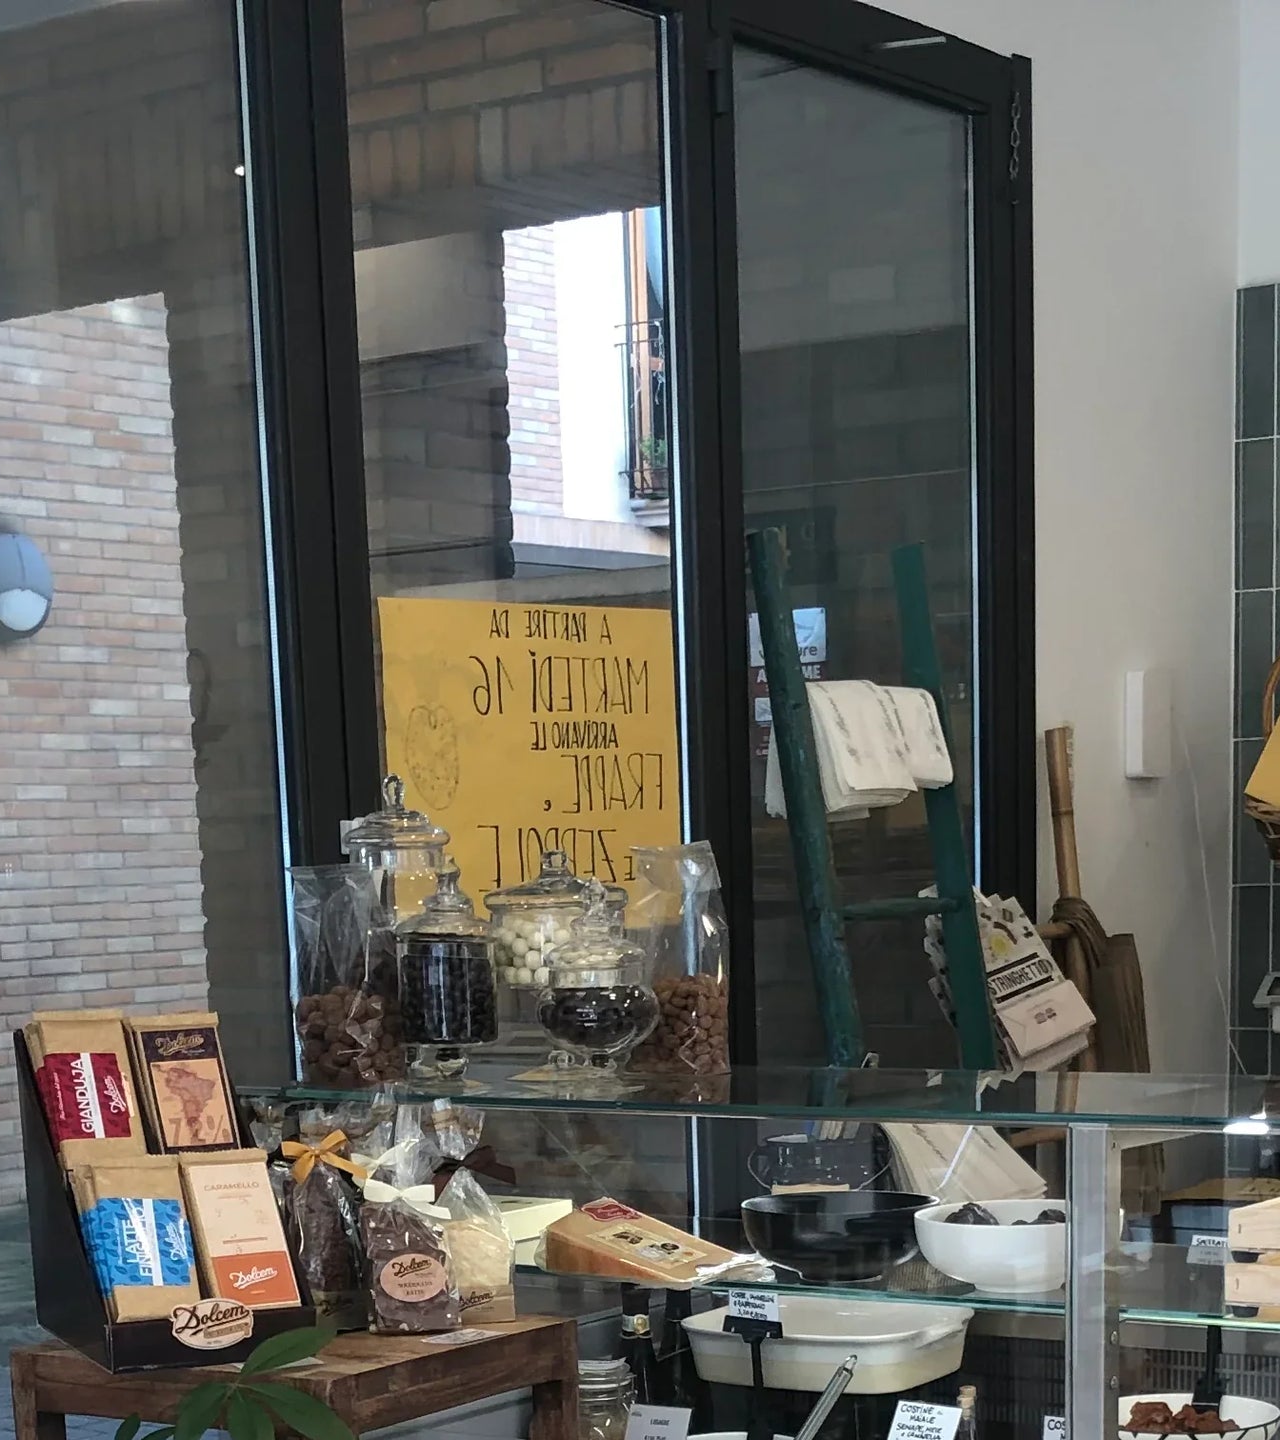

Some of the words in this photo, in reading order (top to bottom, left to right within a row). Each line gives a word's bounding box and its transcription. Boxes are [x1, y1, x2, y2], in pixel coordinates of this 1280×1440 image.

[70, 1058, 96, 1134] GIANDUJA
[203, 1181, 260, 1192] CARAMELLO
[229, 1266, 278, 1290] Dolcem
[173, 1302, 251, 1336] Dolcem
[901, 1403, 934, 1415] COSTINE
